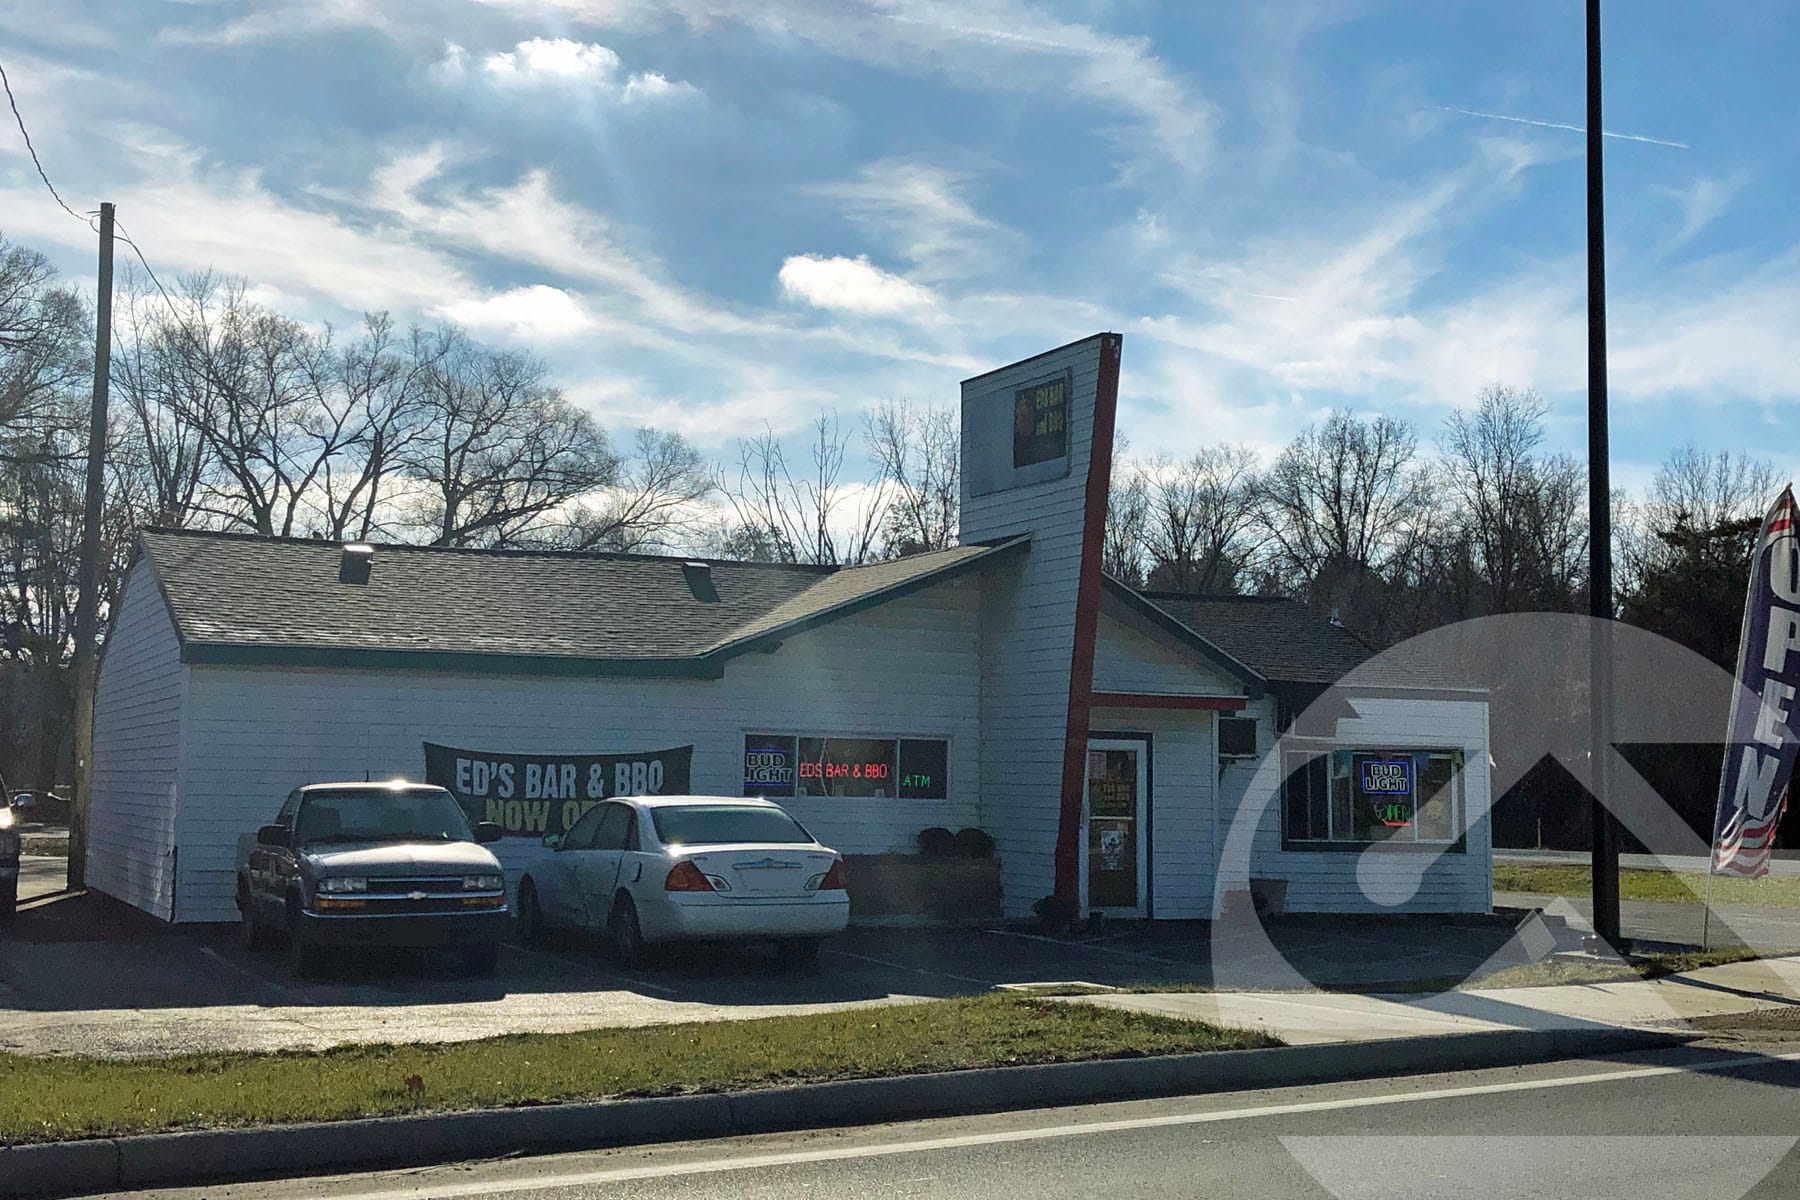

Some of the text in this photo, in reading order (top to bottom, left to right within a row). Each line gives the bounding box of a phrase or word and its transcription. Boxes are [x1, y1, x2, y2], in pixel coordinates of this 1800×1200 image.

[746, 752, 785, 768] BUD
[456, 757, 664, 799] ED'S BAR & BBQ
[825, 763, 849, 777] BAR
[853, 763, 861, 778] &
[1371, 764, 1402, 777] BUD
[902, 773, 930, 788] ATM
[1365, 776, 1407, 791] LIGHT
[485, 799, 550, 832] NOW
